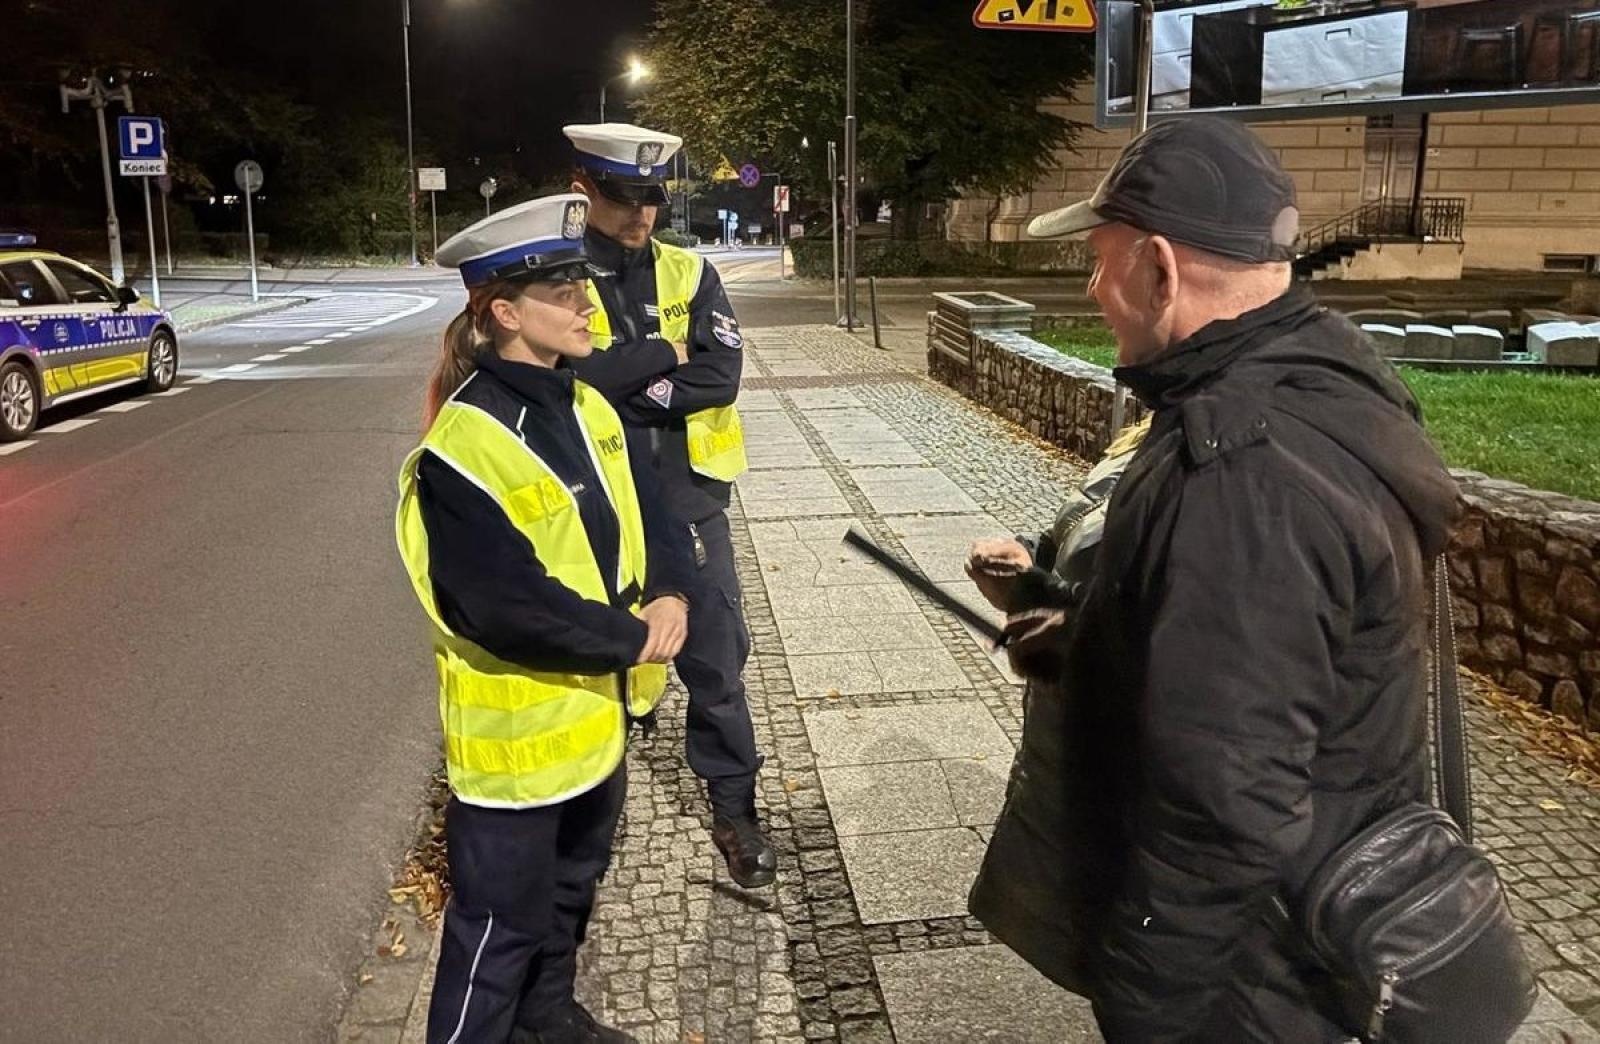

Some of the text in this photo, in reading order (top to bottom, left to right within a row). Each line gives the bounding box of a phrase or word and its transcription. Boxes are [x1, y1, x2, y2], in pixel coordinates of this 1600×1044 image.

[129, 122, 153, 153] P
[124, 162, 161, 173] Koniec
[100, 319, 136, 339] POLICJA
